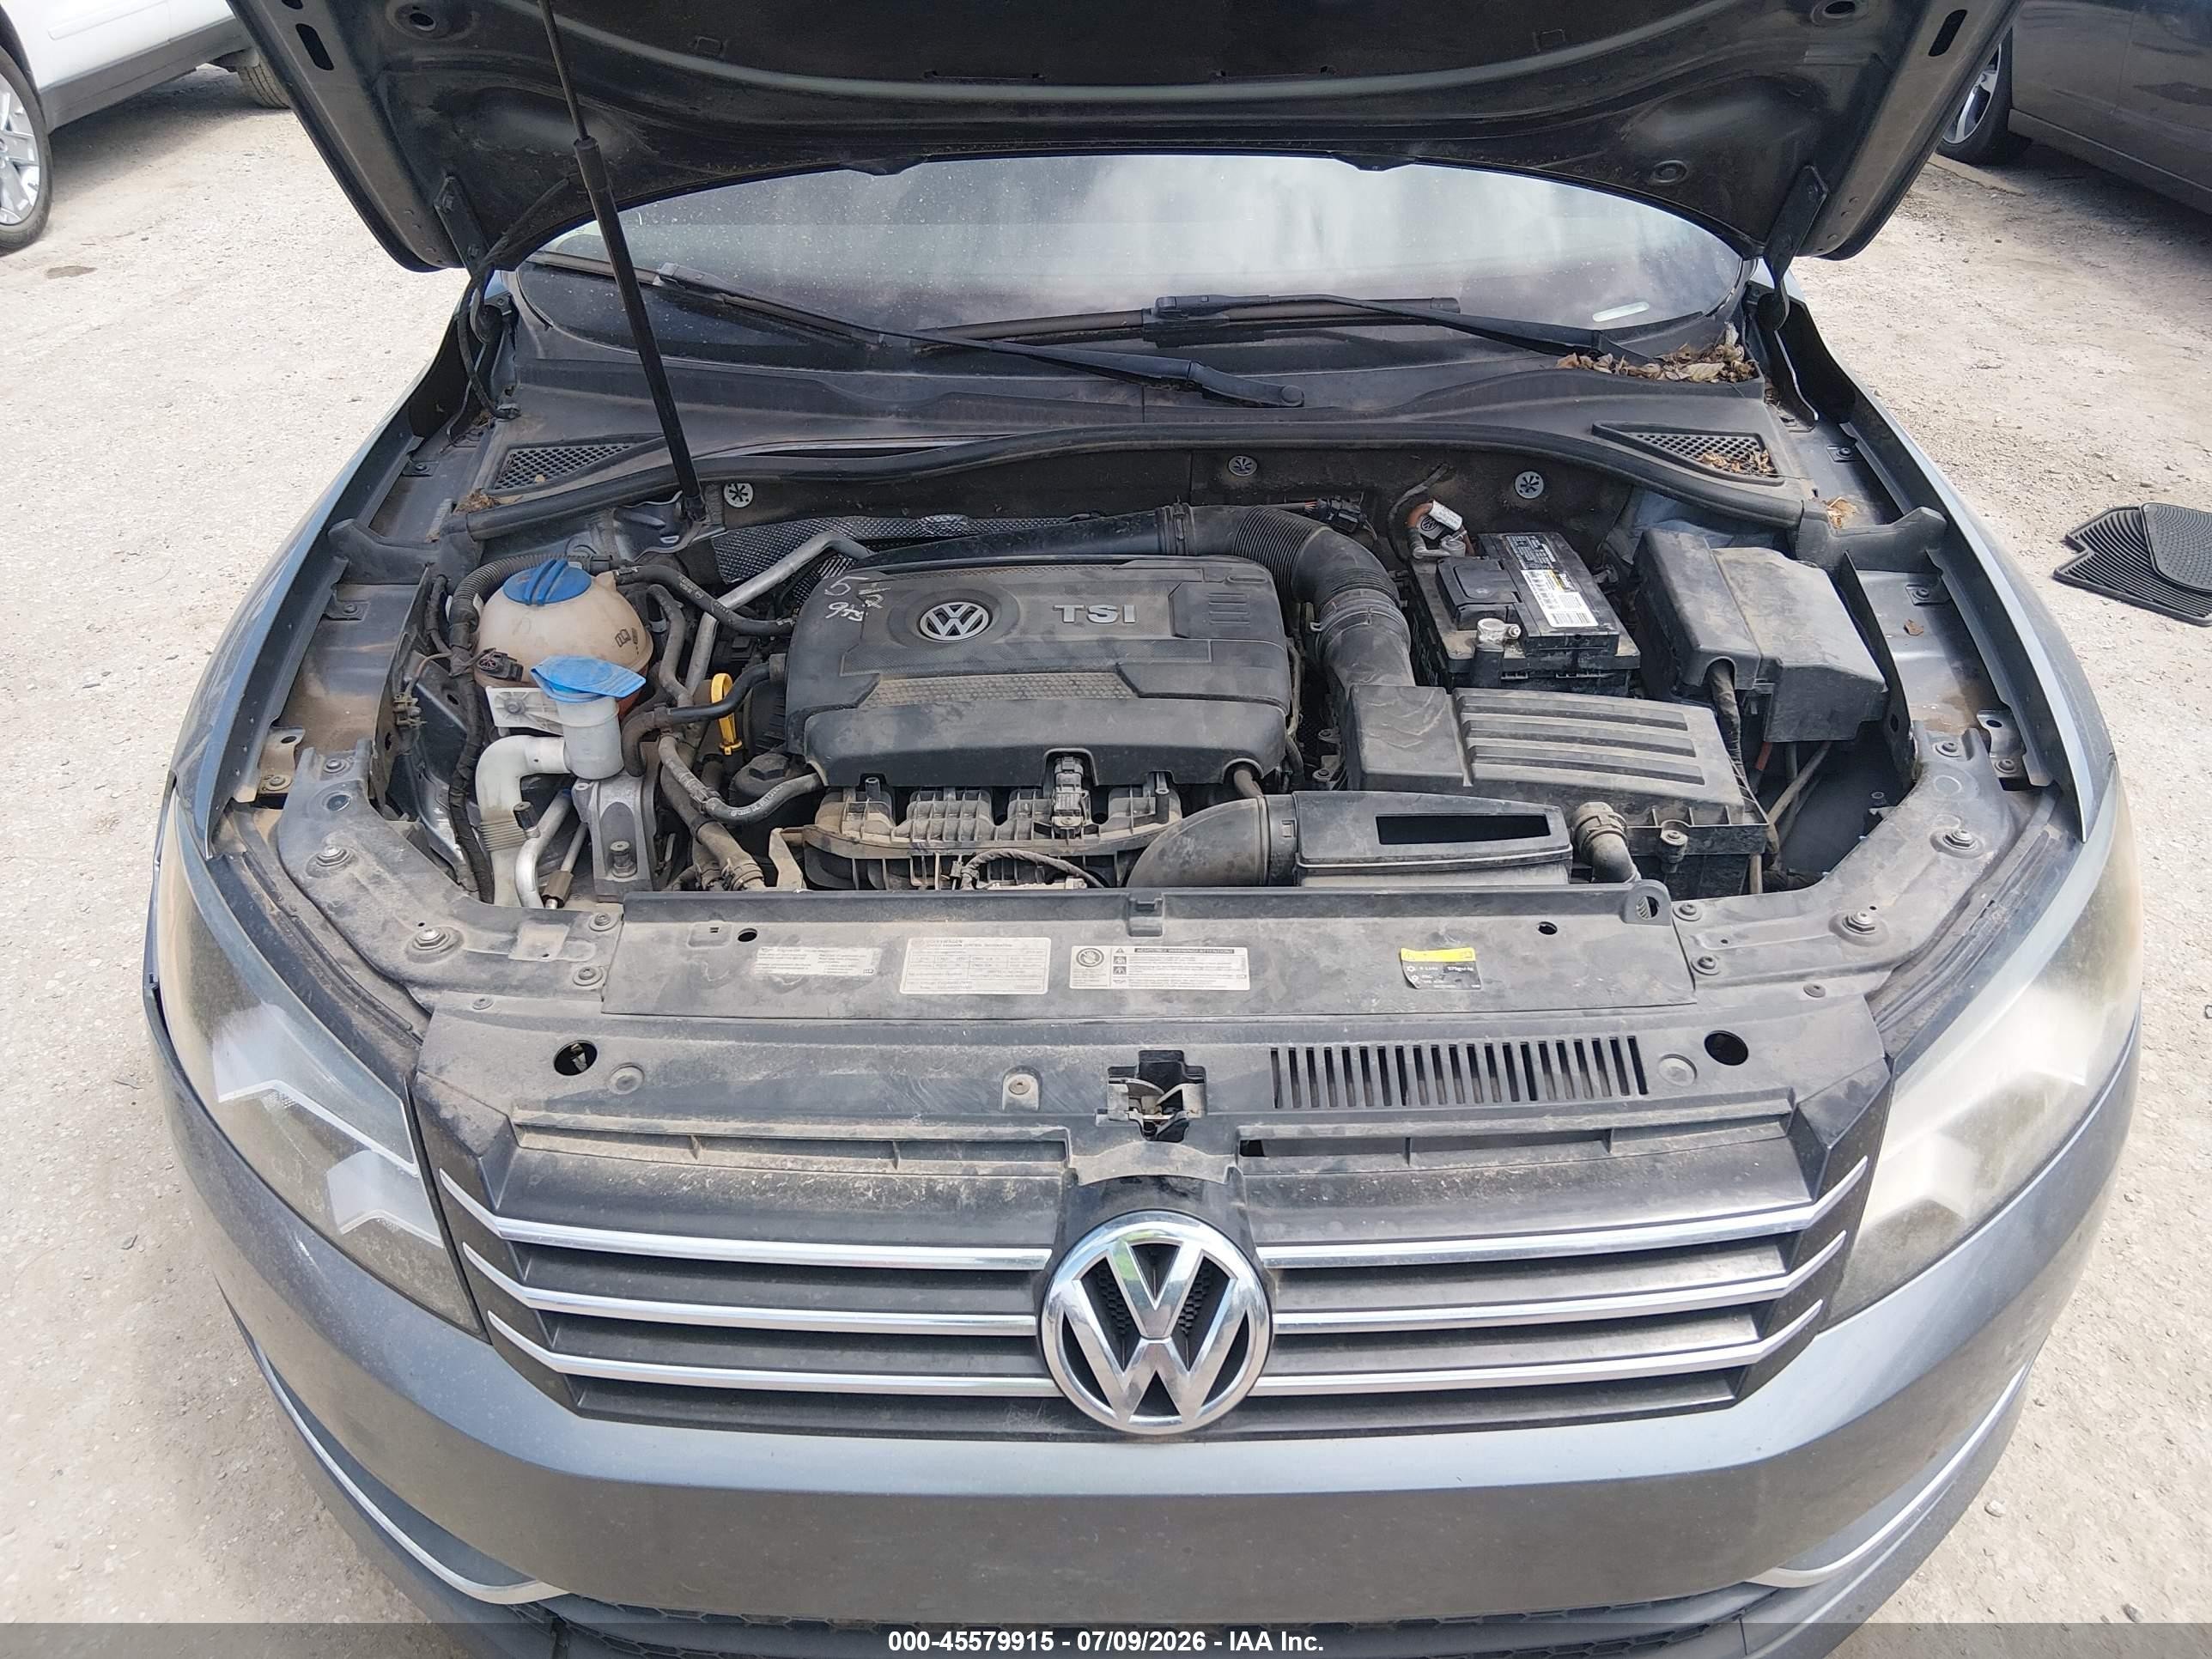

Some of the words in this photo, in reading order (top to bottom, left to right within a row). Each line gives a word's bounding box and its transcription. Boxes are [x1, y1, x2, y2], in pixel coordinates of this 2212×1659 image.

[919, 600, 990, 642] VW
[1052, 604, 1137, 624] TSI
[1045, 1212, 1268, 1431] VW
